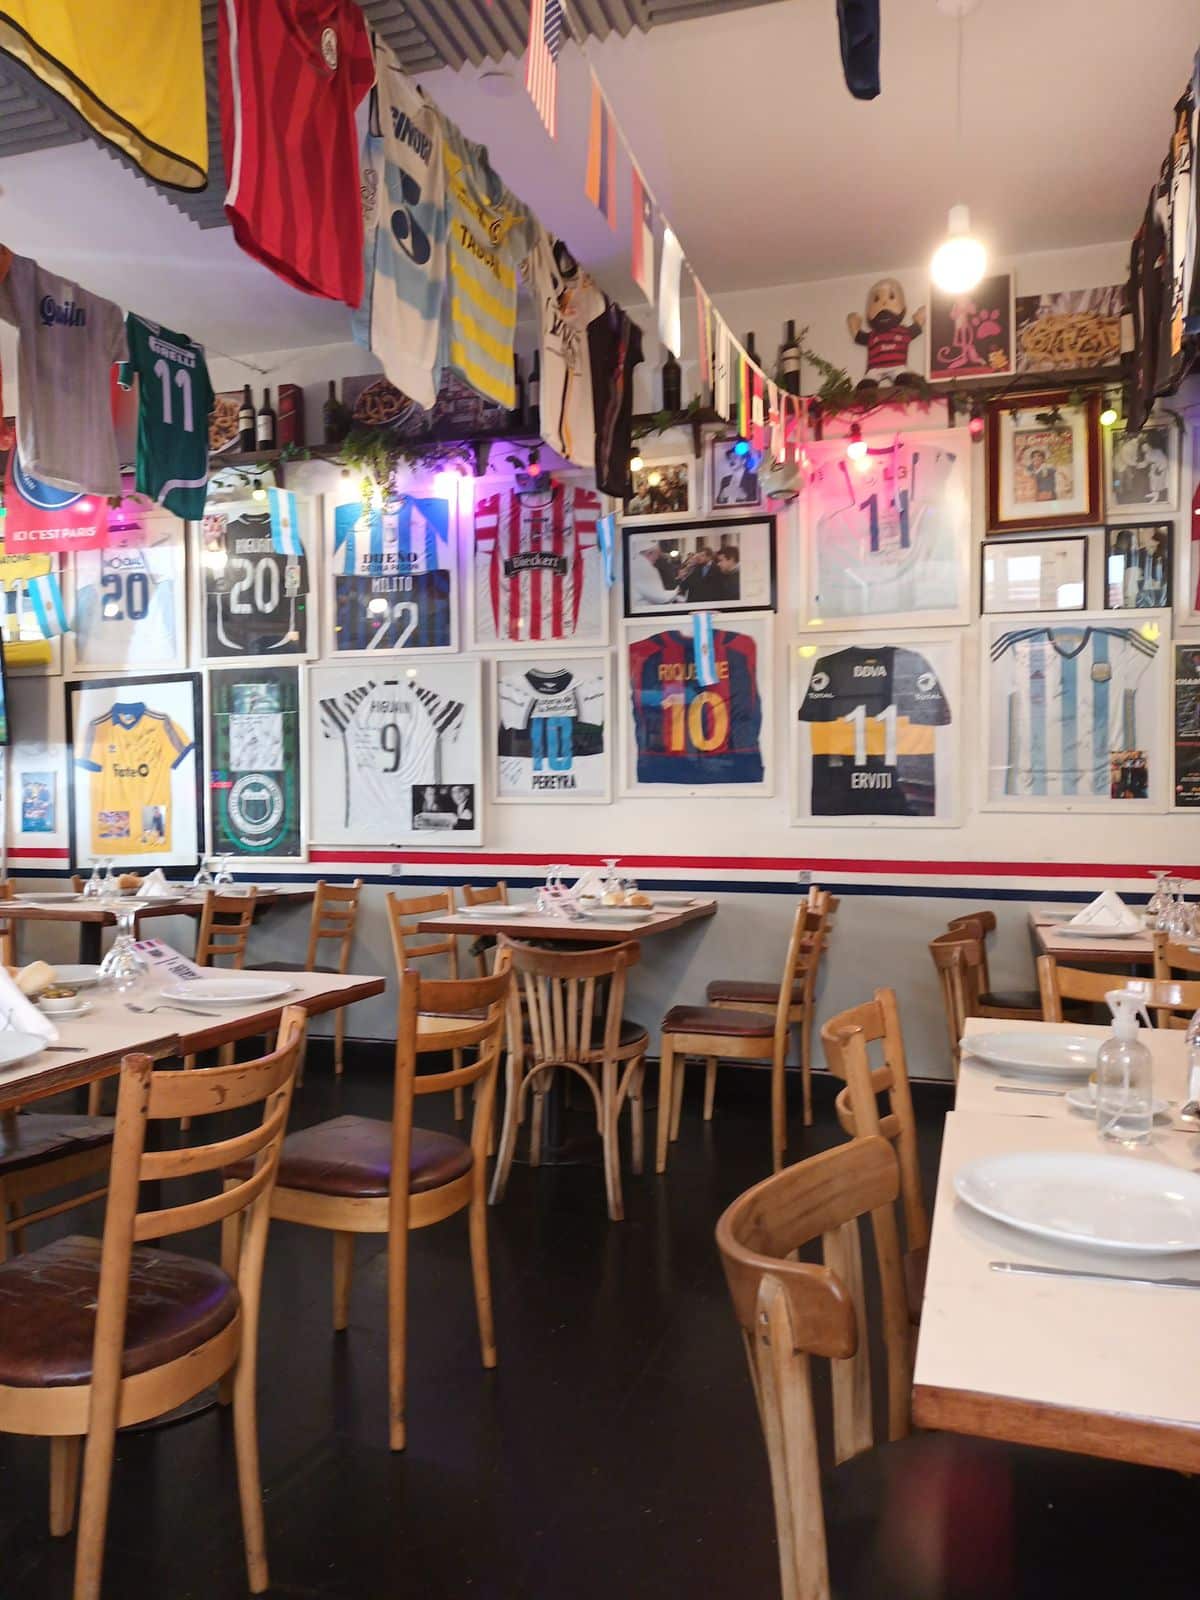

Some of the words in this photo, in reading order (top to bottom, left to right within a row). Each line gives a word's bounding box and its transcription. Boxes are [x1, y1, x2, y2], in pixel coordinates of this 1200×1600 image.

[154, 359, 195, 433] 11
[101, 573, 149, 621] 20
[230, 557, 280, 614] 20
[371, 576, 413, 593] MILITO
[853, 665, 887, 678] BBVA
[530, 717, 573, 771] 10
[660, 690, 729, 752] 10
[843, 704, 898, 766] 11
[380, 723, 401, 773] 9
[851, 772, 893, 789] ERVITI
